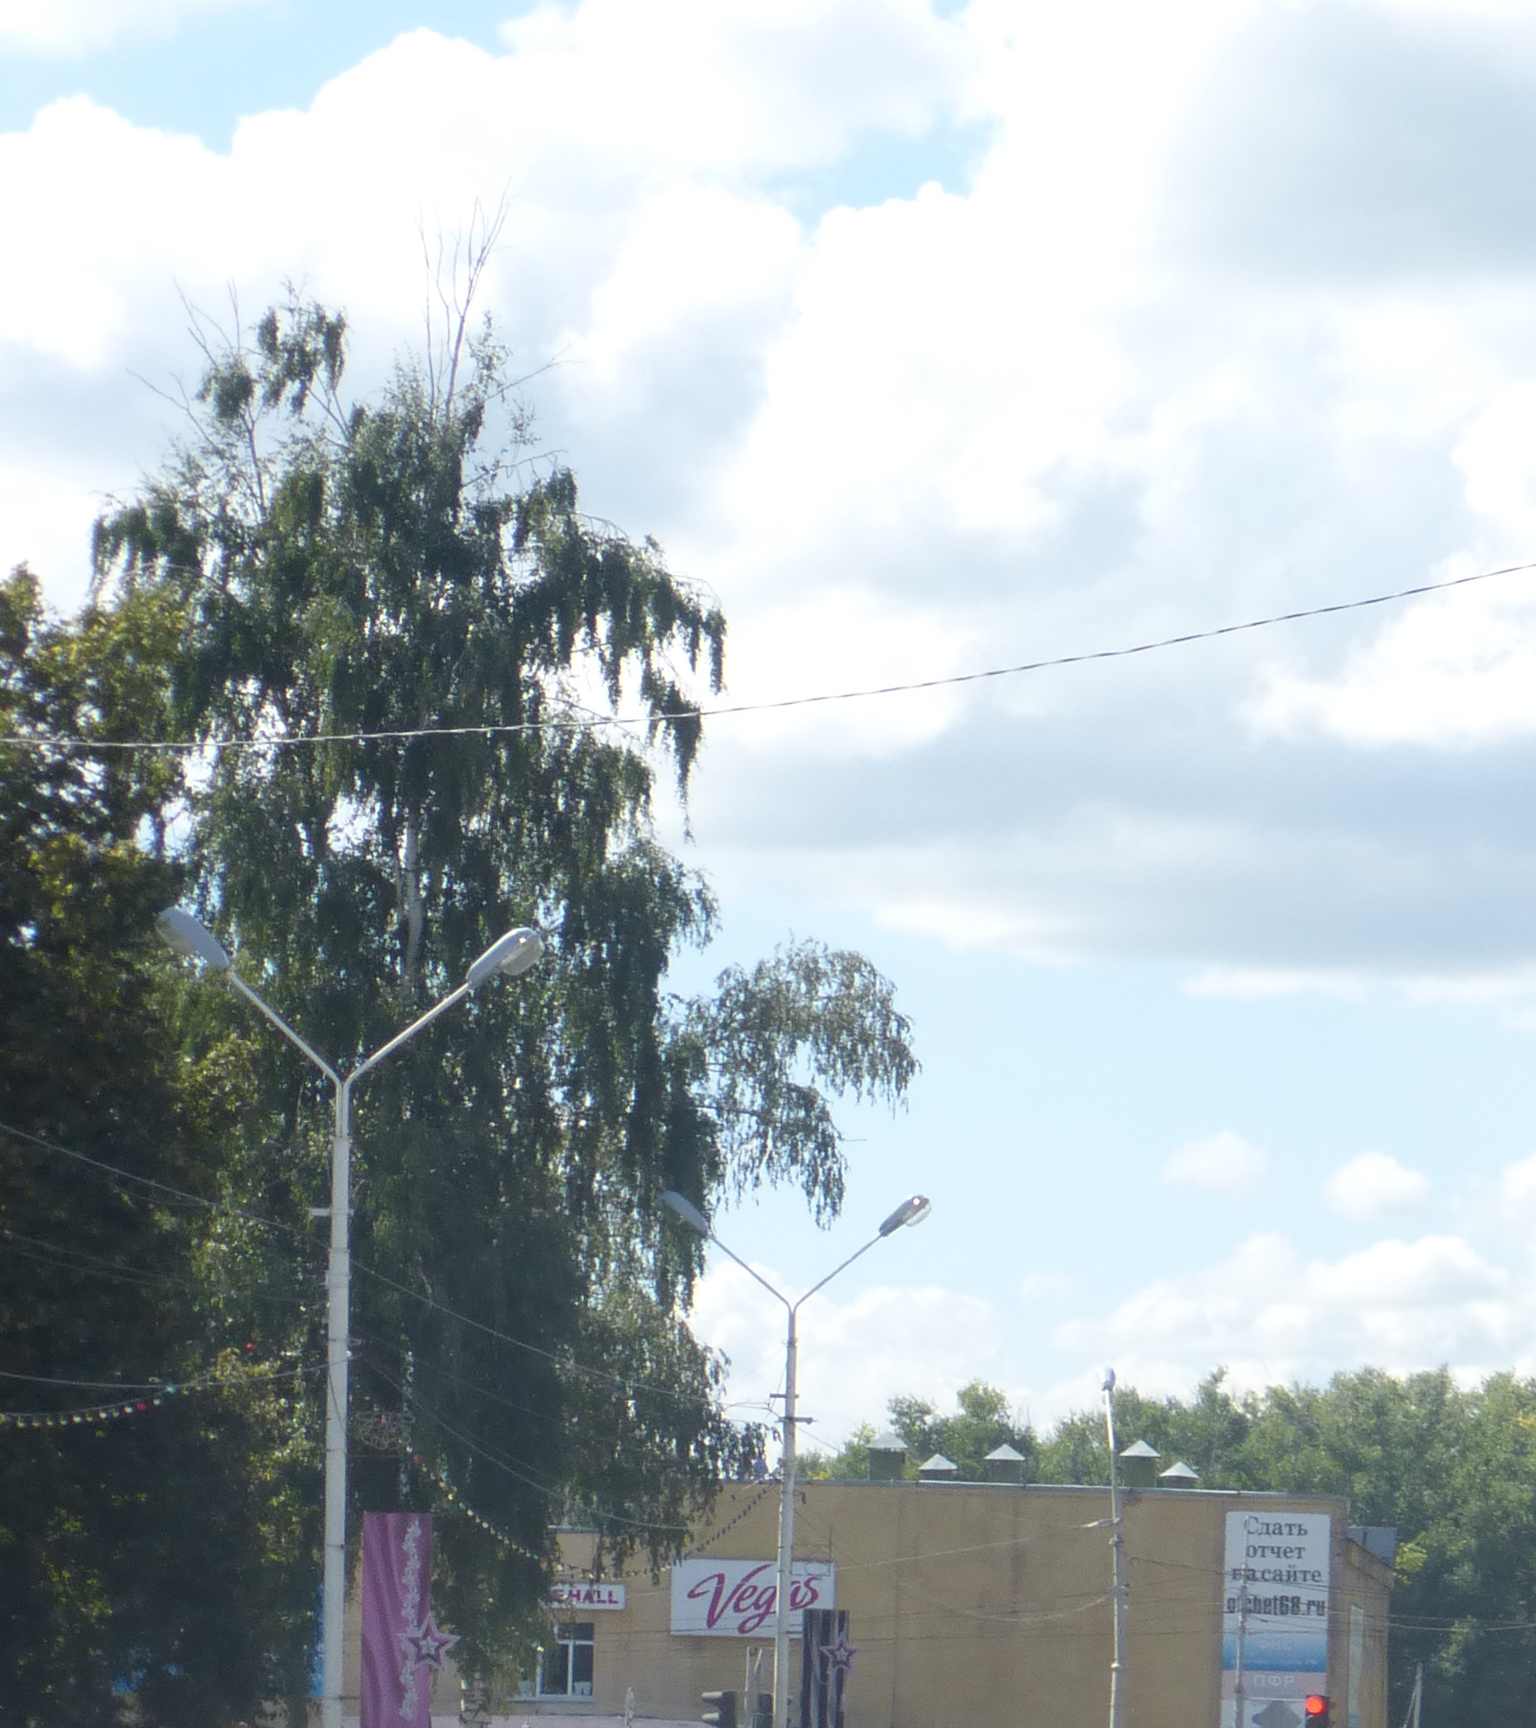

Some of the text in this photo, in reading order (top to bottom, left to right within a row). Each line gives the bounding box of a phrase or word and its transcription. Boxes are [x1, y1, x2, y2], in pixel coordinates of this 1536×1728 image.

[1245, 1515, 1308, 1536] Сдать
[1246, 1544, 1306, 1560] отчет
[1261, 1563, 1322, 1583] сайте
[567, 1587, 619, 1604] HALL
[687, 1564, 818, 1634] Vegas
